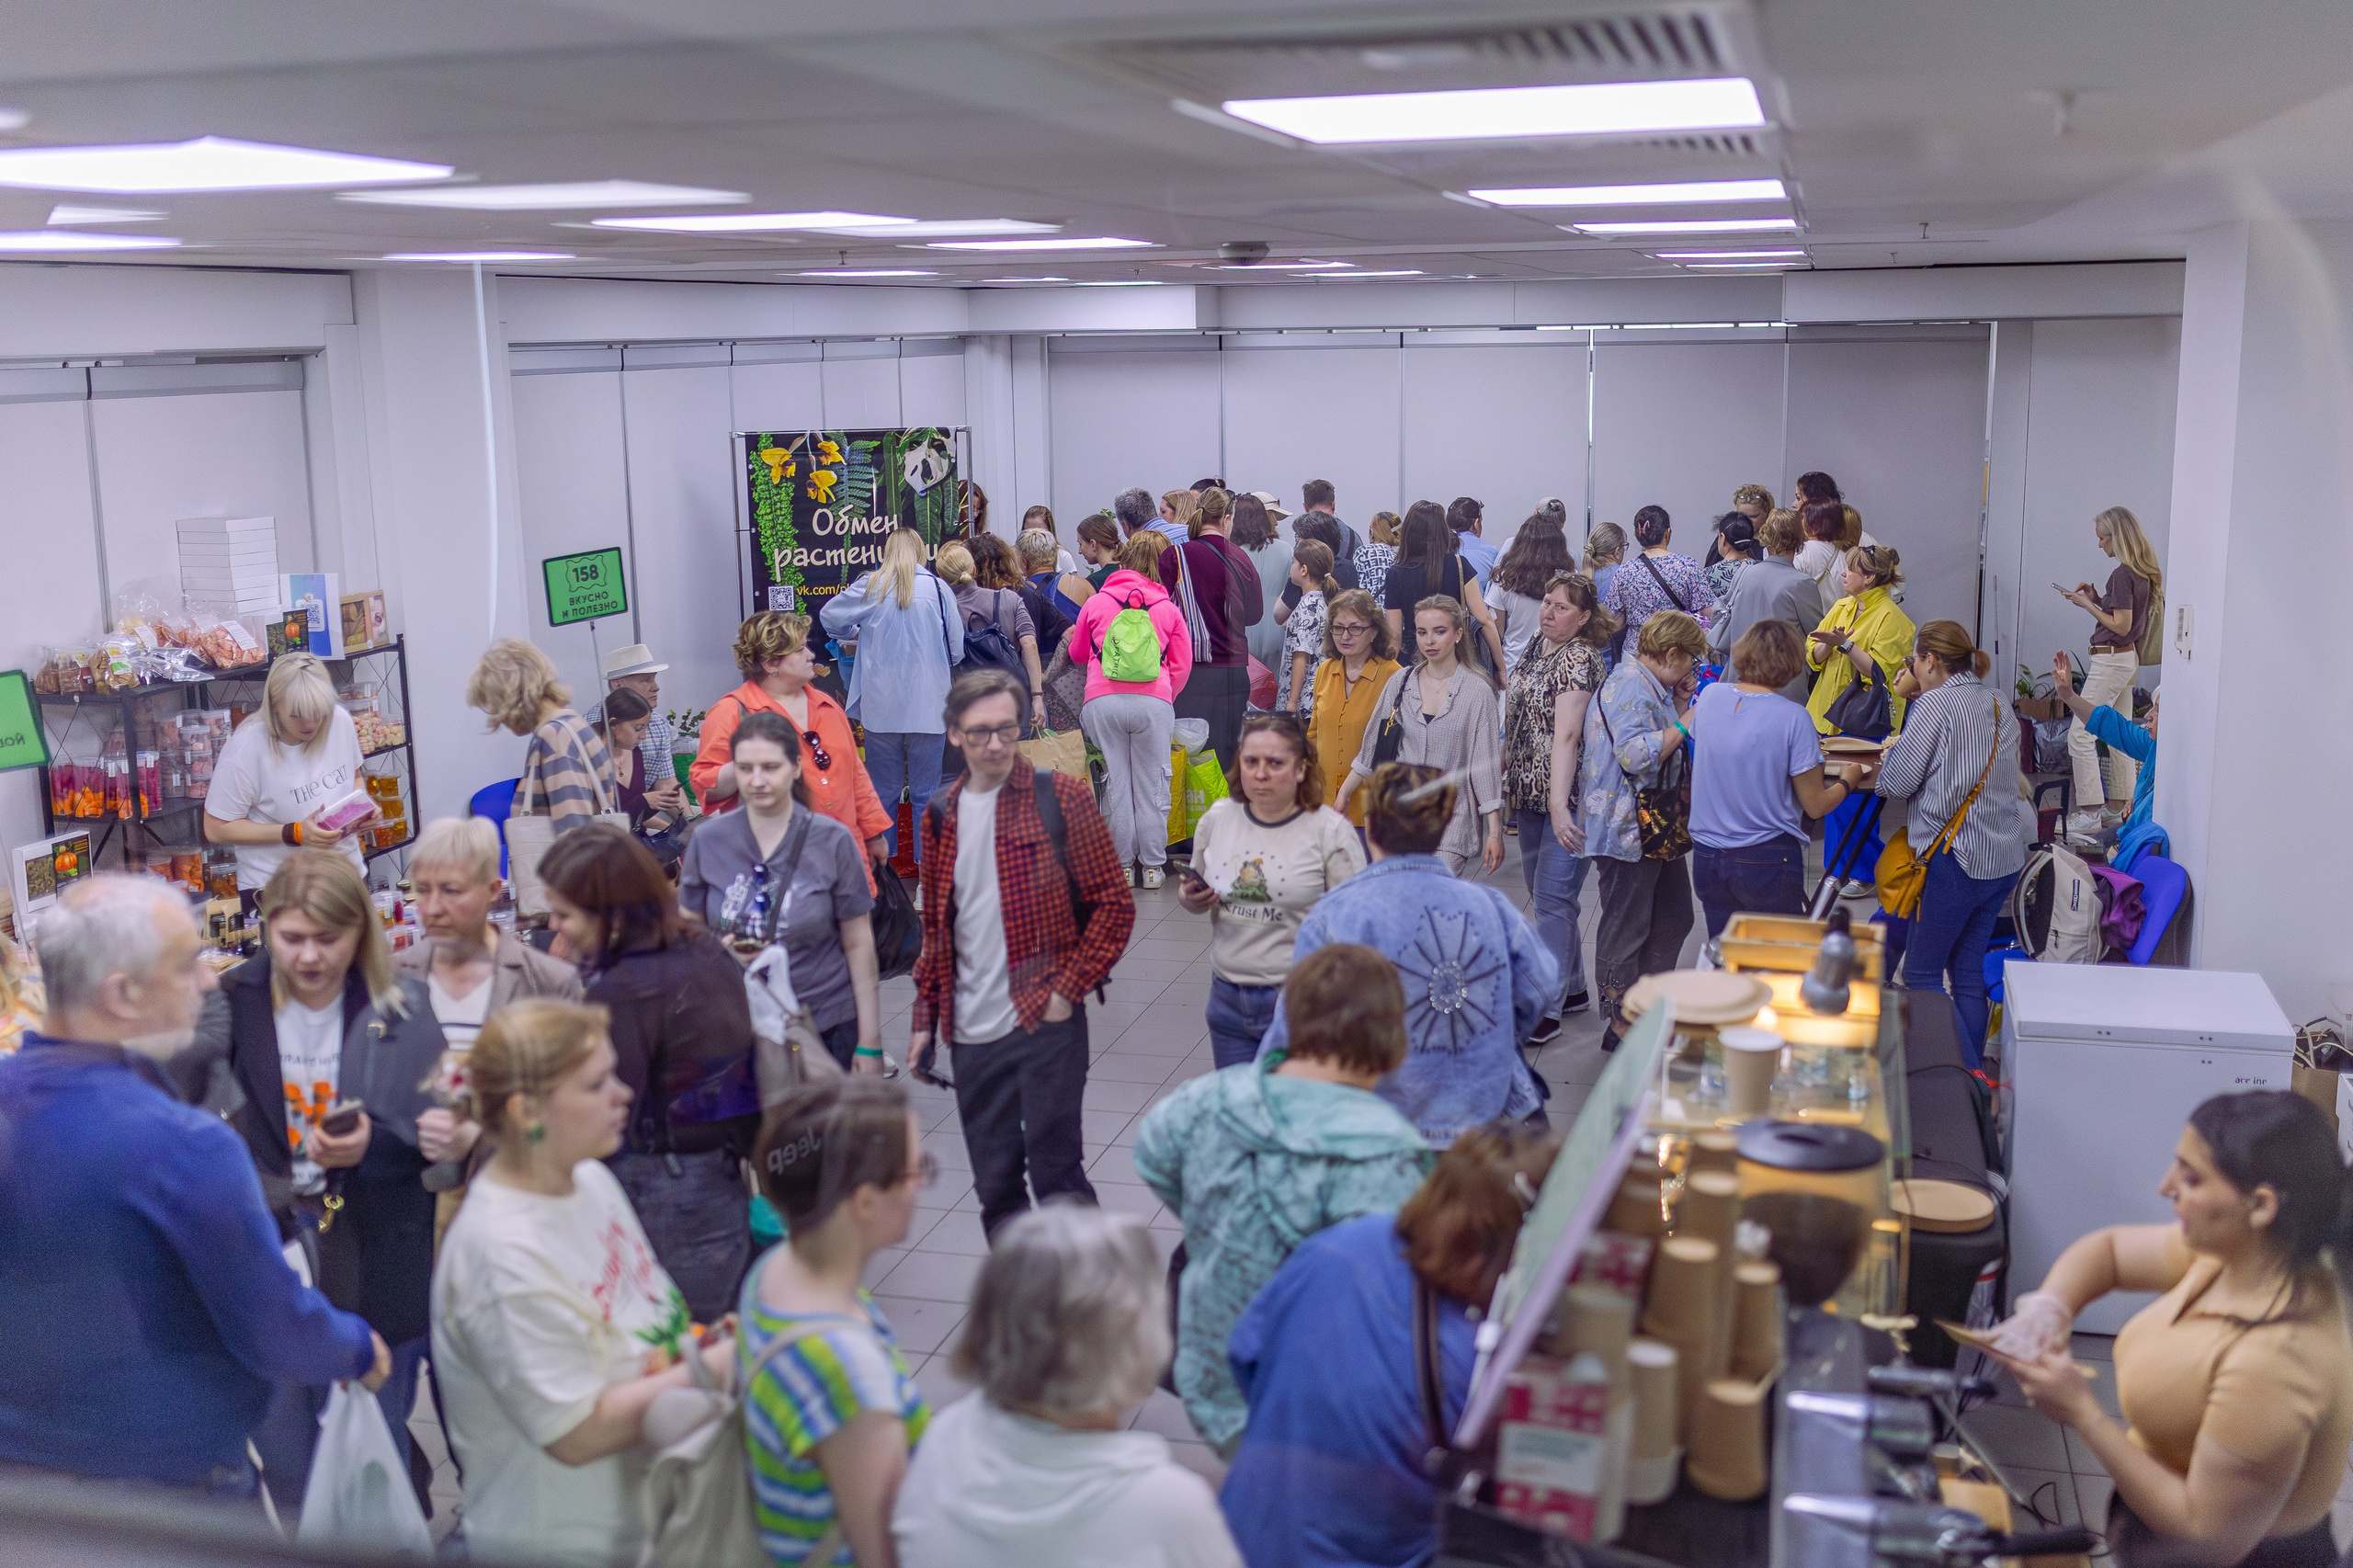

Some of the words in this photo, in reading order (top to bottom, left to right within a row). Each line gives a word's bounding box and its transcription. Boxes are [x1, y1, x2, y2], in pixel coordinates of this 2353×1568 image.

[812, 504, 899, 536] Обмен
[572, 563, 599, 583] 158
[569, 591, 608, 607] ВКУСНО
[562, 610, 568, 619] И
[572, 600, 618, 617] ПОЛЕЗНО
[1261, 906, 1283, 922] Me
